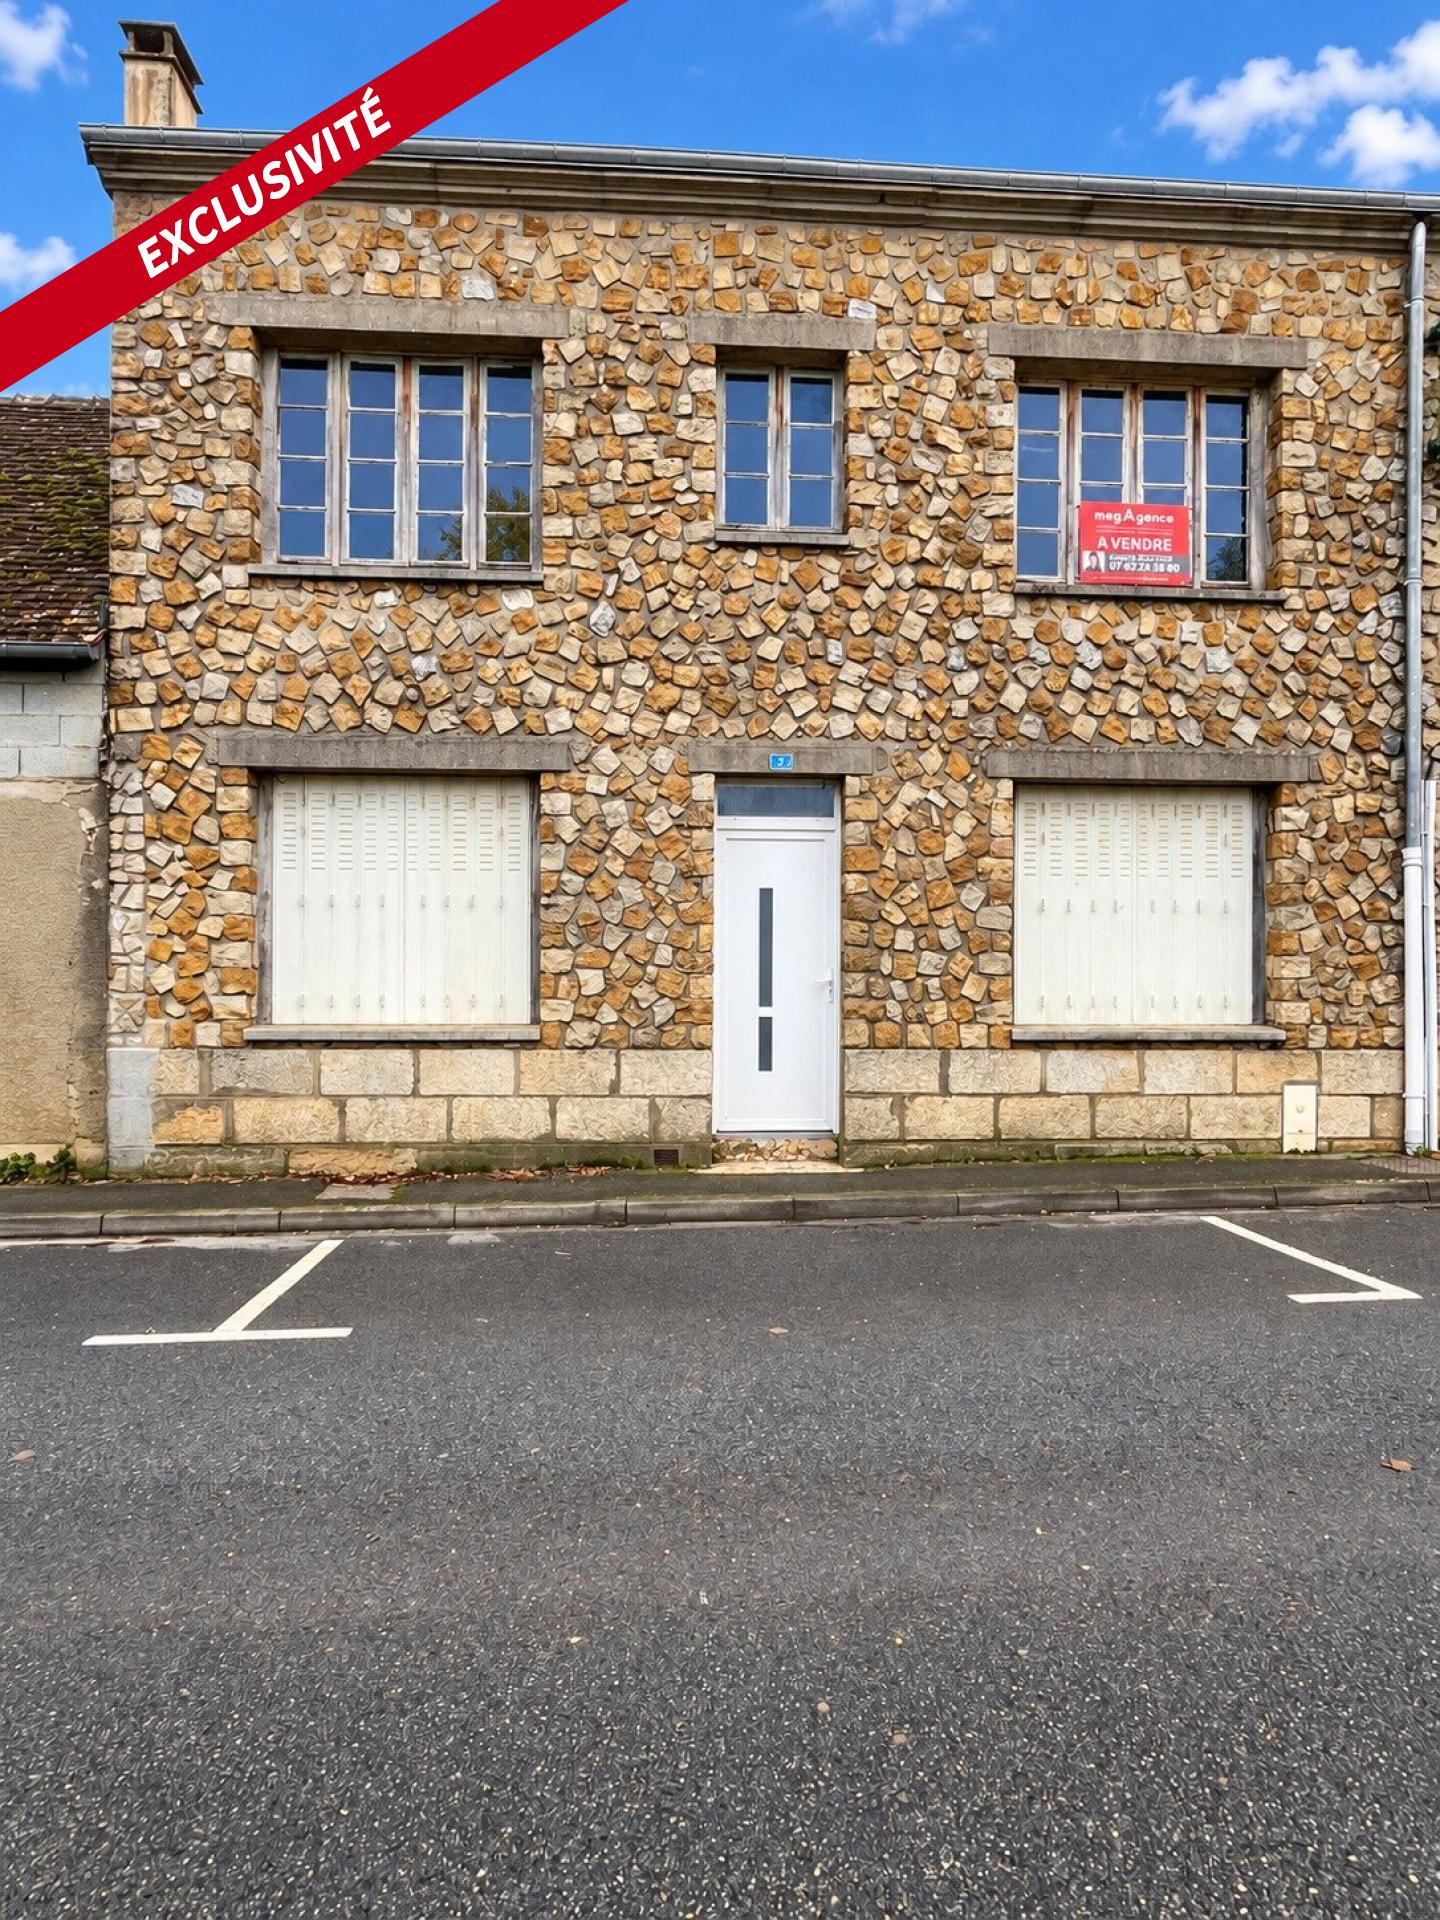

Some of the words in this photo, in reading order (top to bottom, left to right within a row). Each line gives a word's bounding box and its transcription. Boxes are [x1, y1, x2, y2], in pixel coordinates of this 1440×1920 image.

[1094, 508, 1174, 525] megAgence
[1097, 536, 1109, 549] A
[1111, 537, 1172, 551] VENDRE
